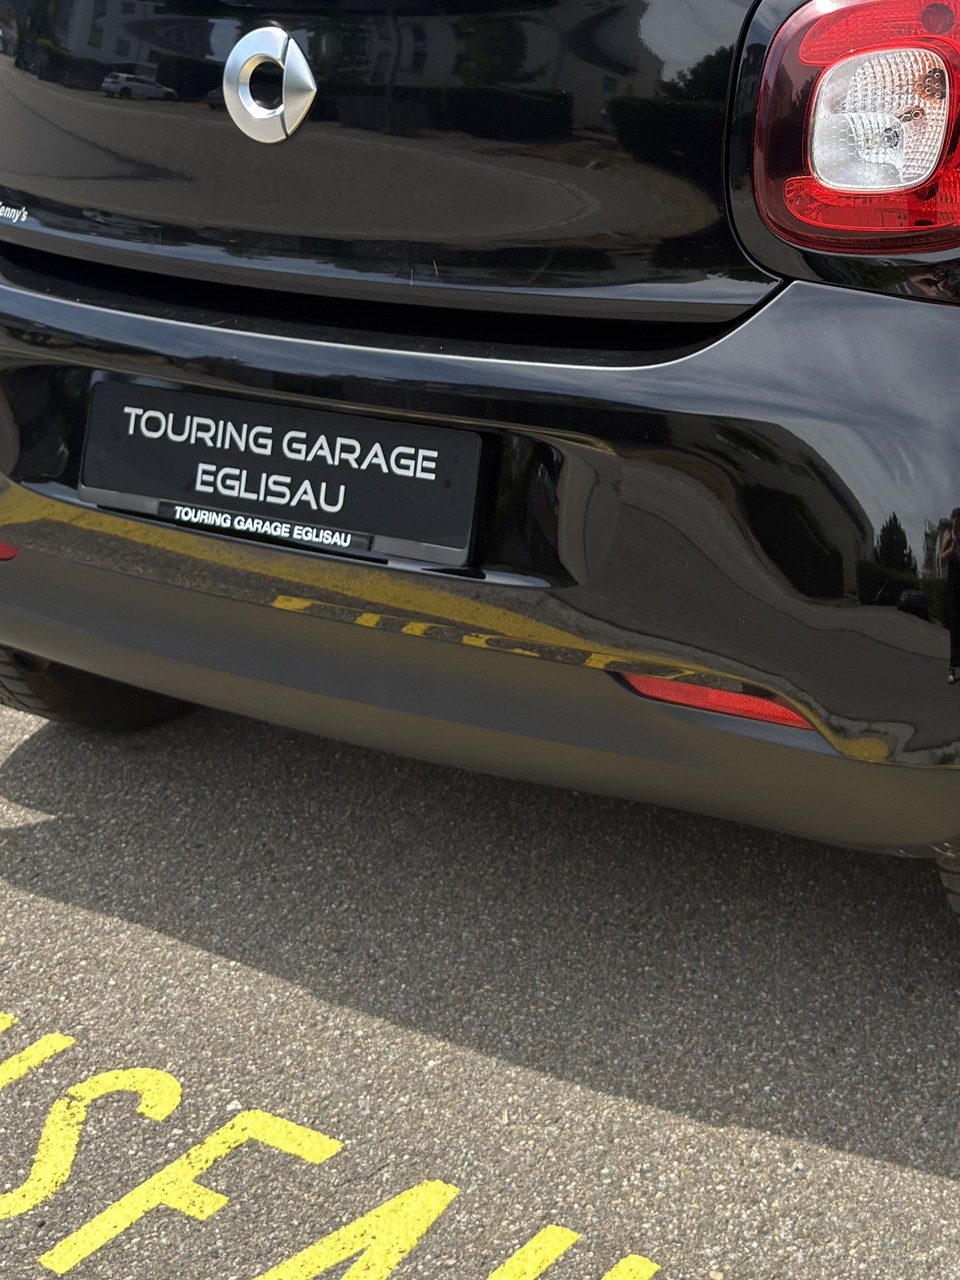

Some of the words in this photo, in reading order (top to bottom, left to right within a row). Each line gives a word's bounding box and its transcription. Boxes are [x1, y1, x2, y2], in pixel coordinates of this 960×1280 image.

[0, 201, 29, 223] enny's
[123, 406, 273, 456] TOURING
[281, 431, 439, 481] GARAGE
[195, 462, 346, 513] EGLISAU
[174, 505, 232, 528] TOURING
[233, 515, 291, 539] GARAGE
[292, 525, 352, 548] EGLISAU
